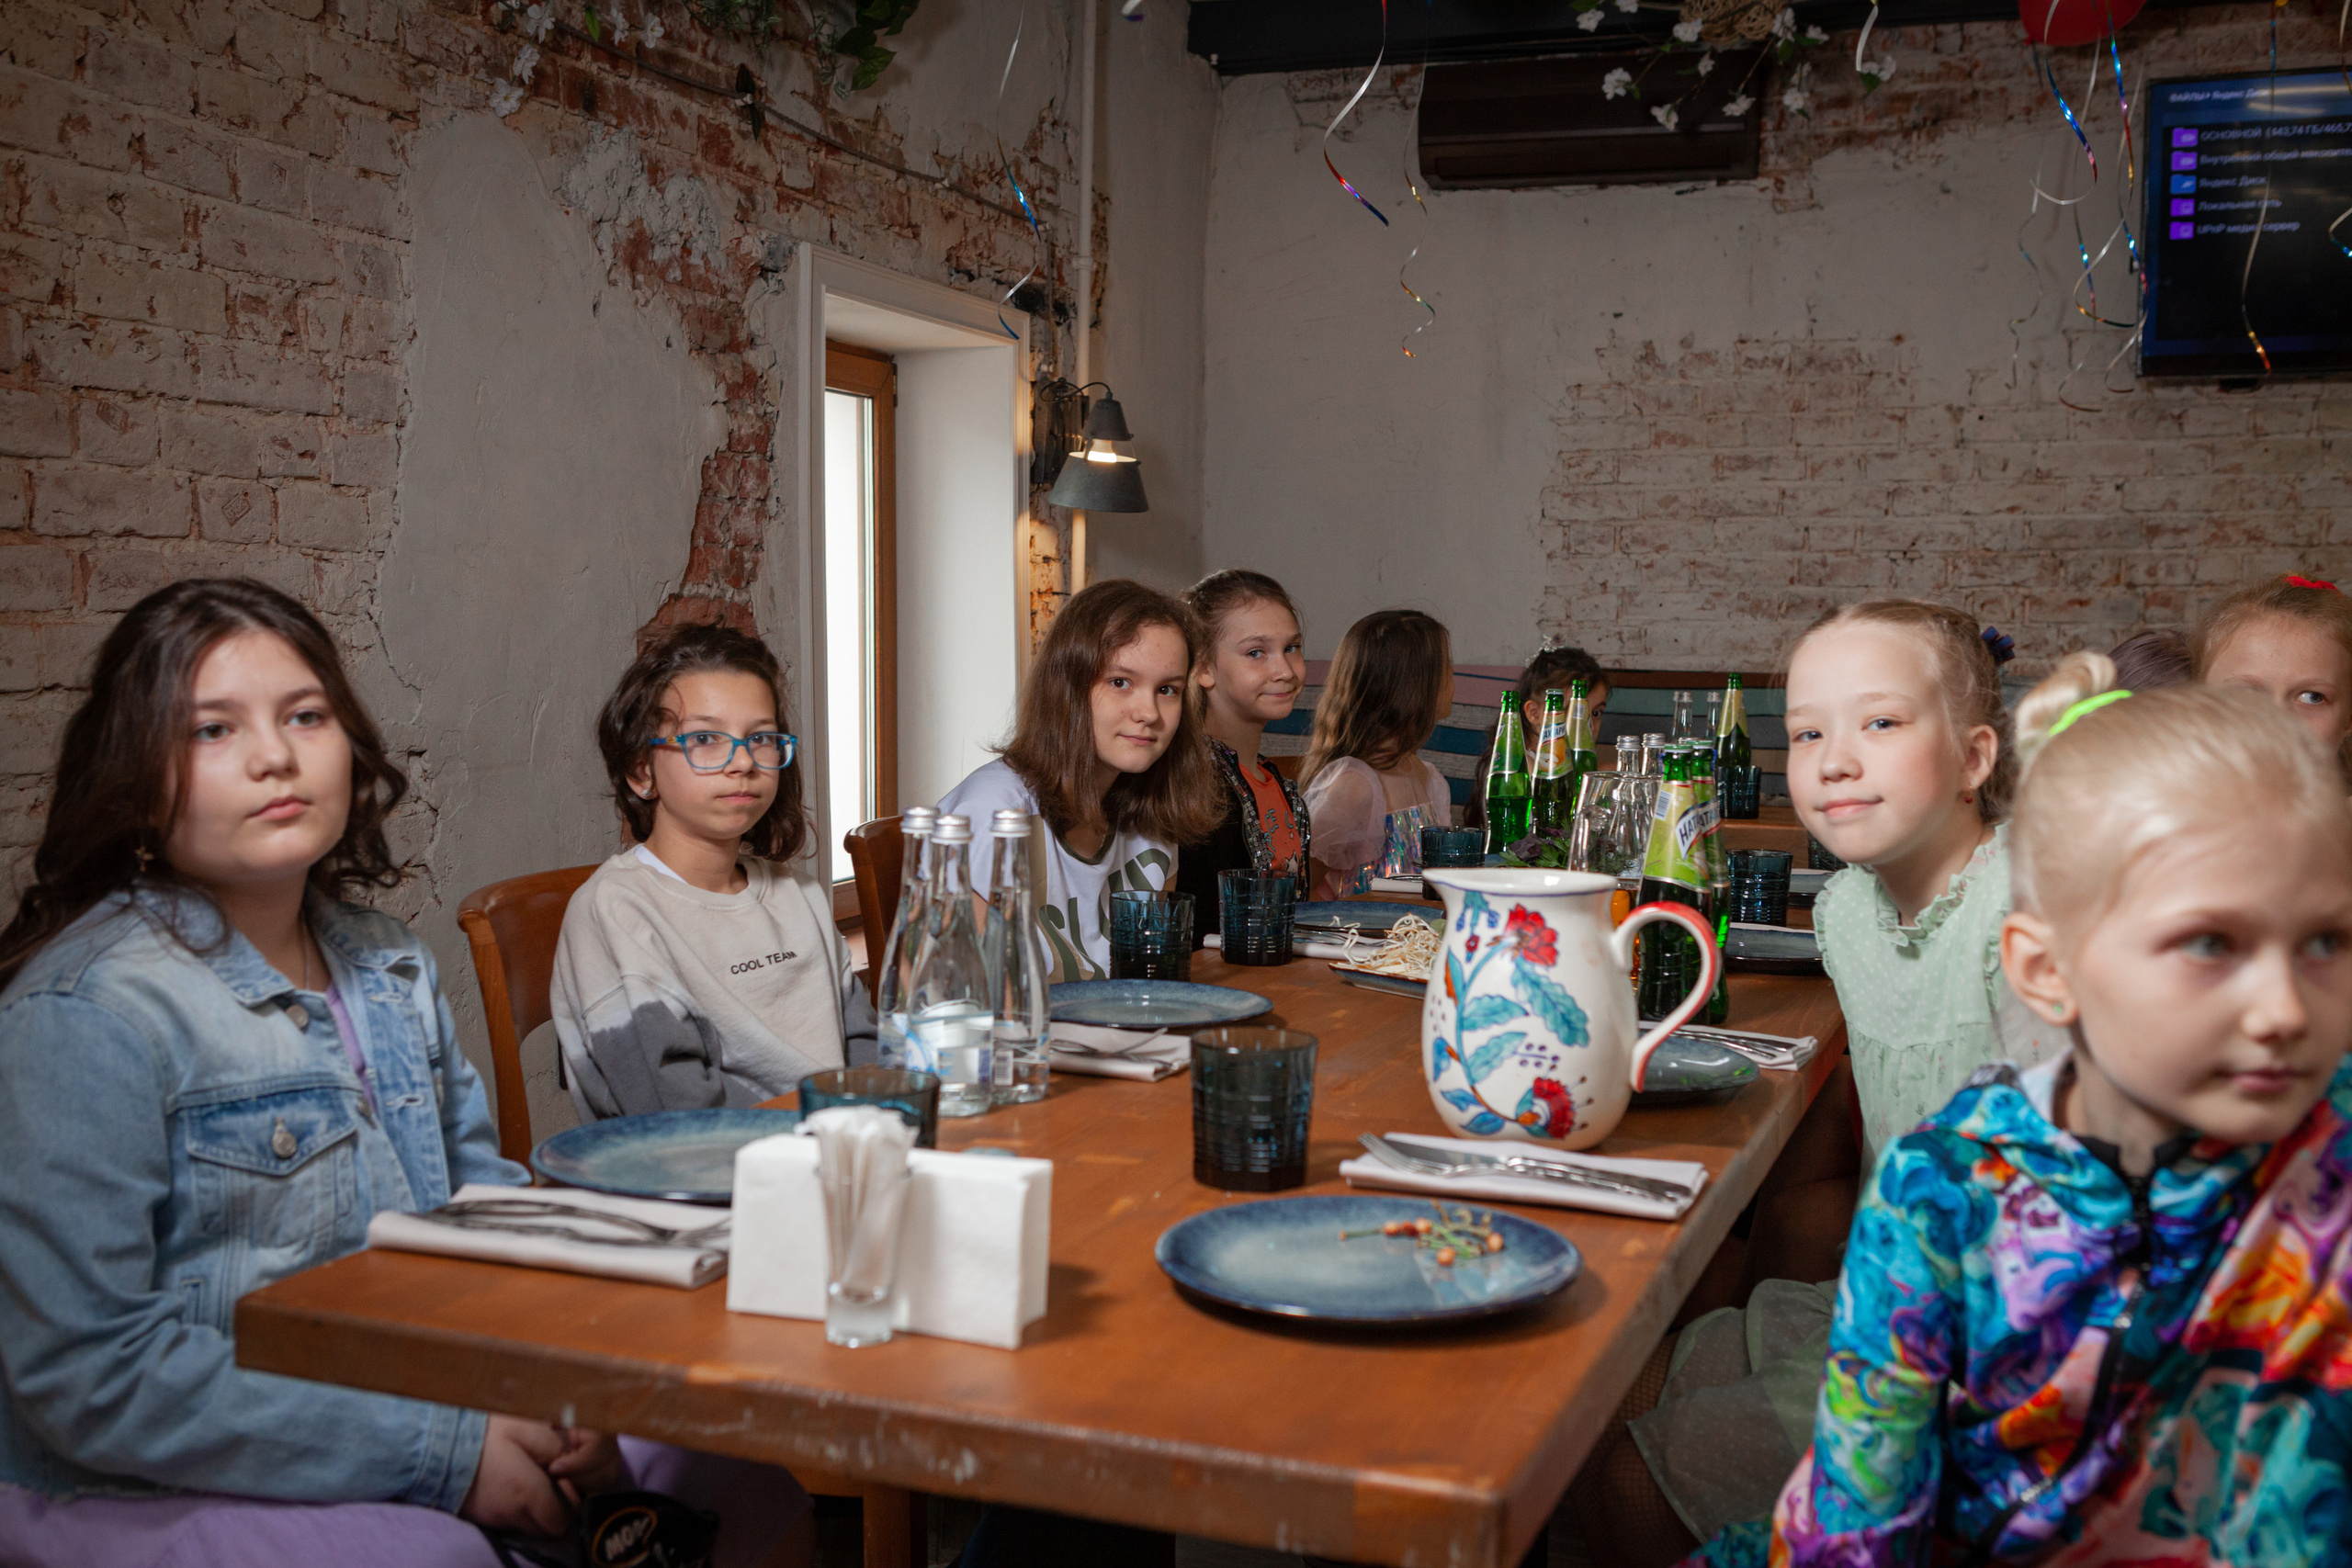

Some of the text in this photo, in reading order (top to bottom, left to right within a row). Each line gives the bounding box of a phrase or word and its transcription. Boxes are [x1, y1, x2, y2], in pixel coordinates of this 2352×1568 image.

[2201, 128, 2262, 141] ОСНОВНОЙ
[2199, 152, 2262, 165] Внутренний
[2263, 150, 2299, 161] общий
[2199, 175, 2267, 188] Яндекс Диск
[2198, 198, 2282, 211] Локальная сеть
[2263, 221, 2301, 233] сервер
[730, 951, 797, 975] COOL TEAM
